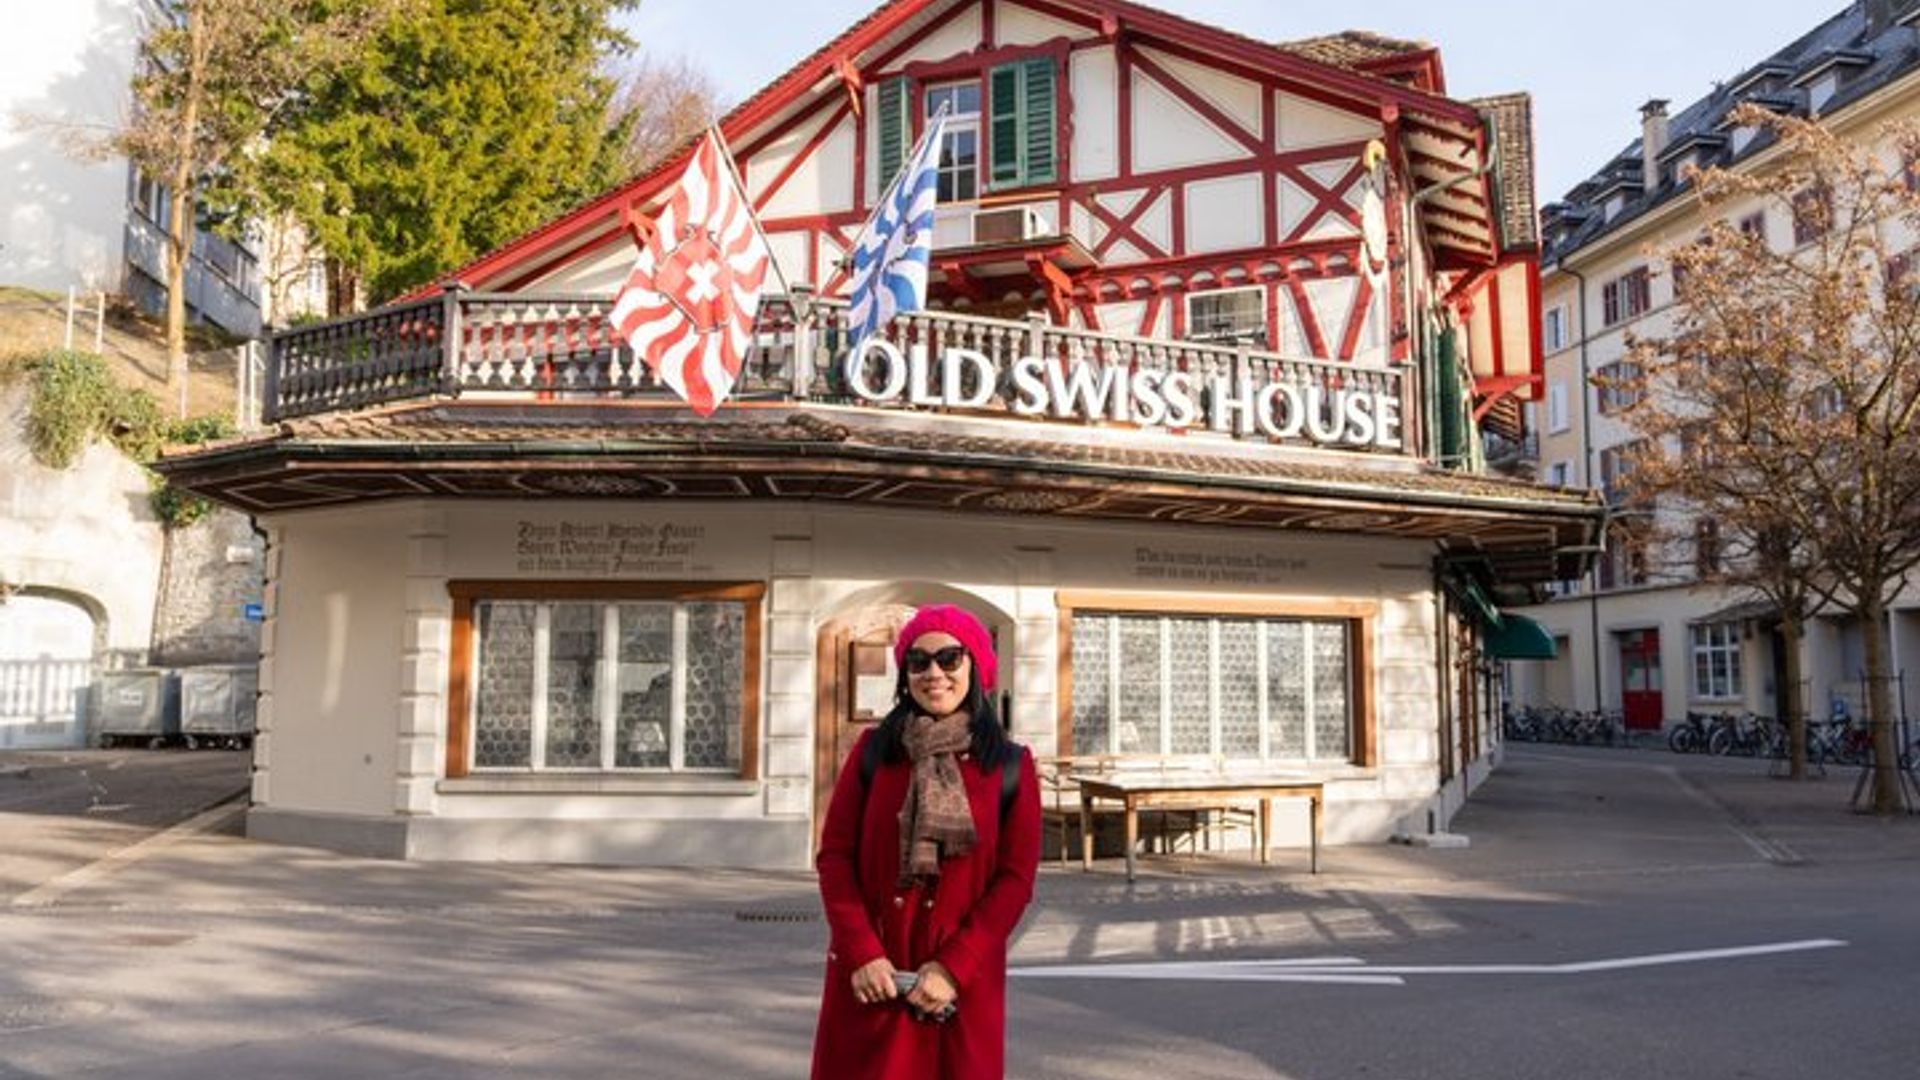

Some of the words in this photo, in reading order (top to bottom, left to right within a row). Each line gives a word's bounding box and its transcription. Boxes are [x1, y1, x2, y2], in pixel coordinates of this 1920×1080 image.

[848, 339, 996, 407] OLD
[1013, 356, 1194, 428] SWISS
[1215, 375, 1401, 447] HOUSE
